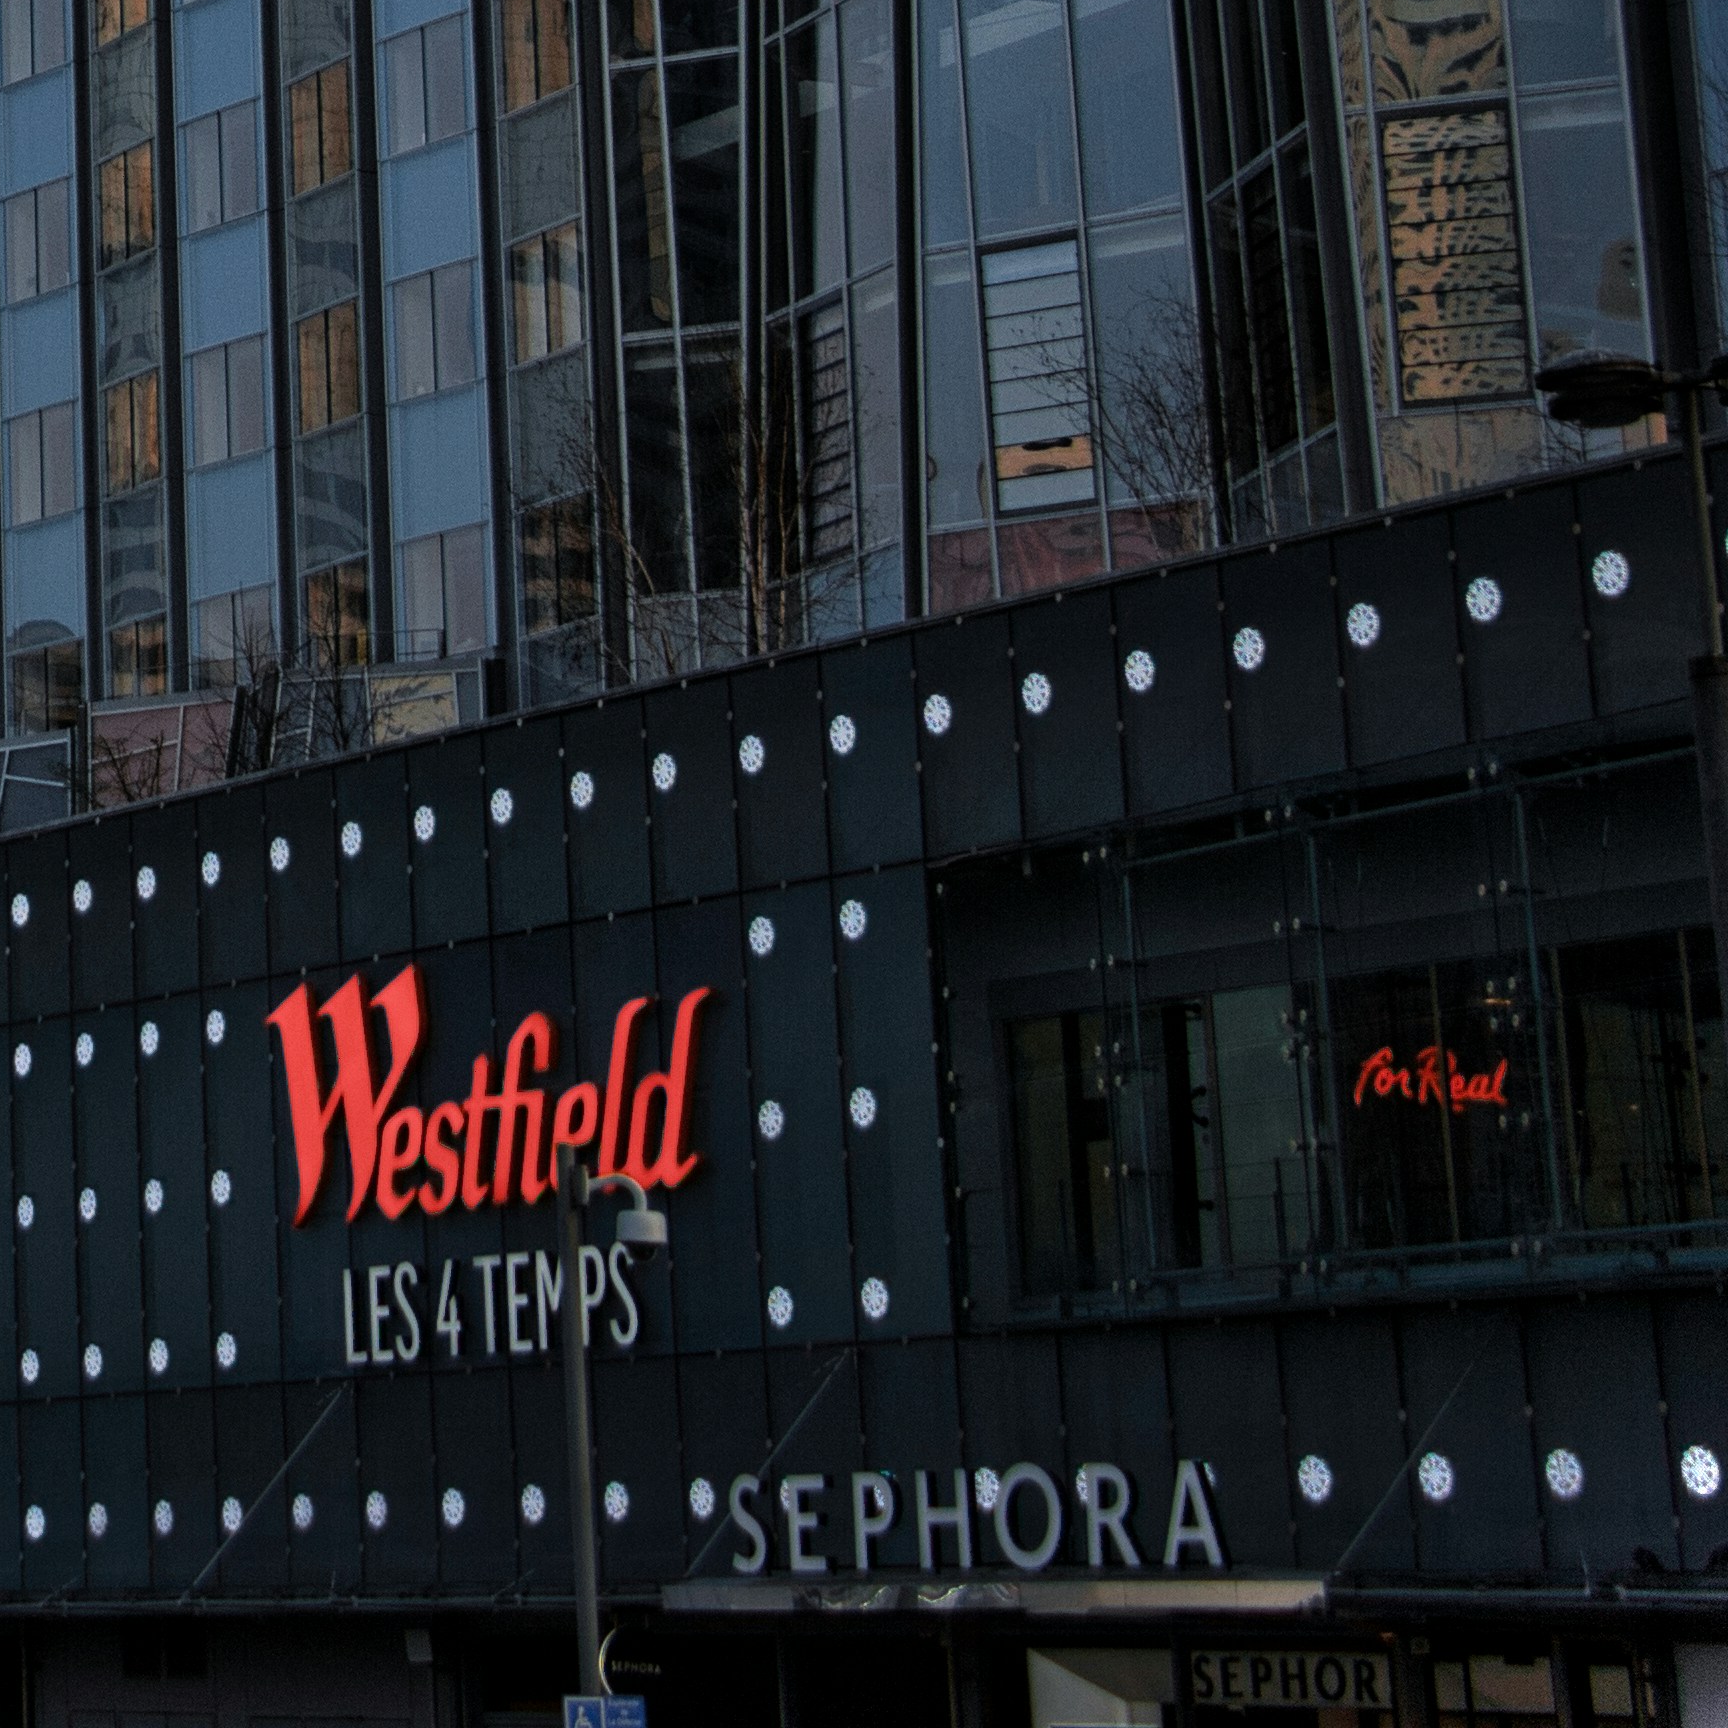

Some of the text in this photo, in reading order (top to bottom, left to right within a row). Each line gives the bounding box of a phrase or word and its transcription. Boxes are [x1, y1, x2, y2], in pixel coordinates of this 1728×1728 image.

[264, 963, 712, 1229] Westfield
[344, 1241, 639, 1365] LES 4 TEMPS
[729, 1459, 1230, 1573] SEPHORA
[611, 1659, 663, 1675] SEPHORA
